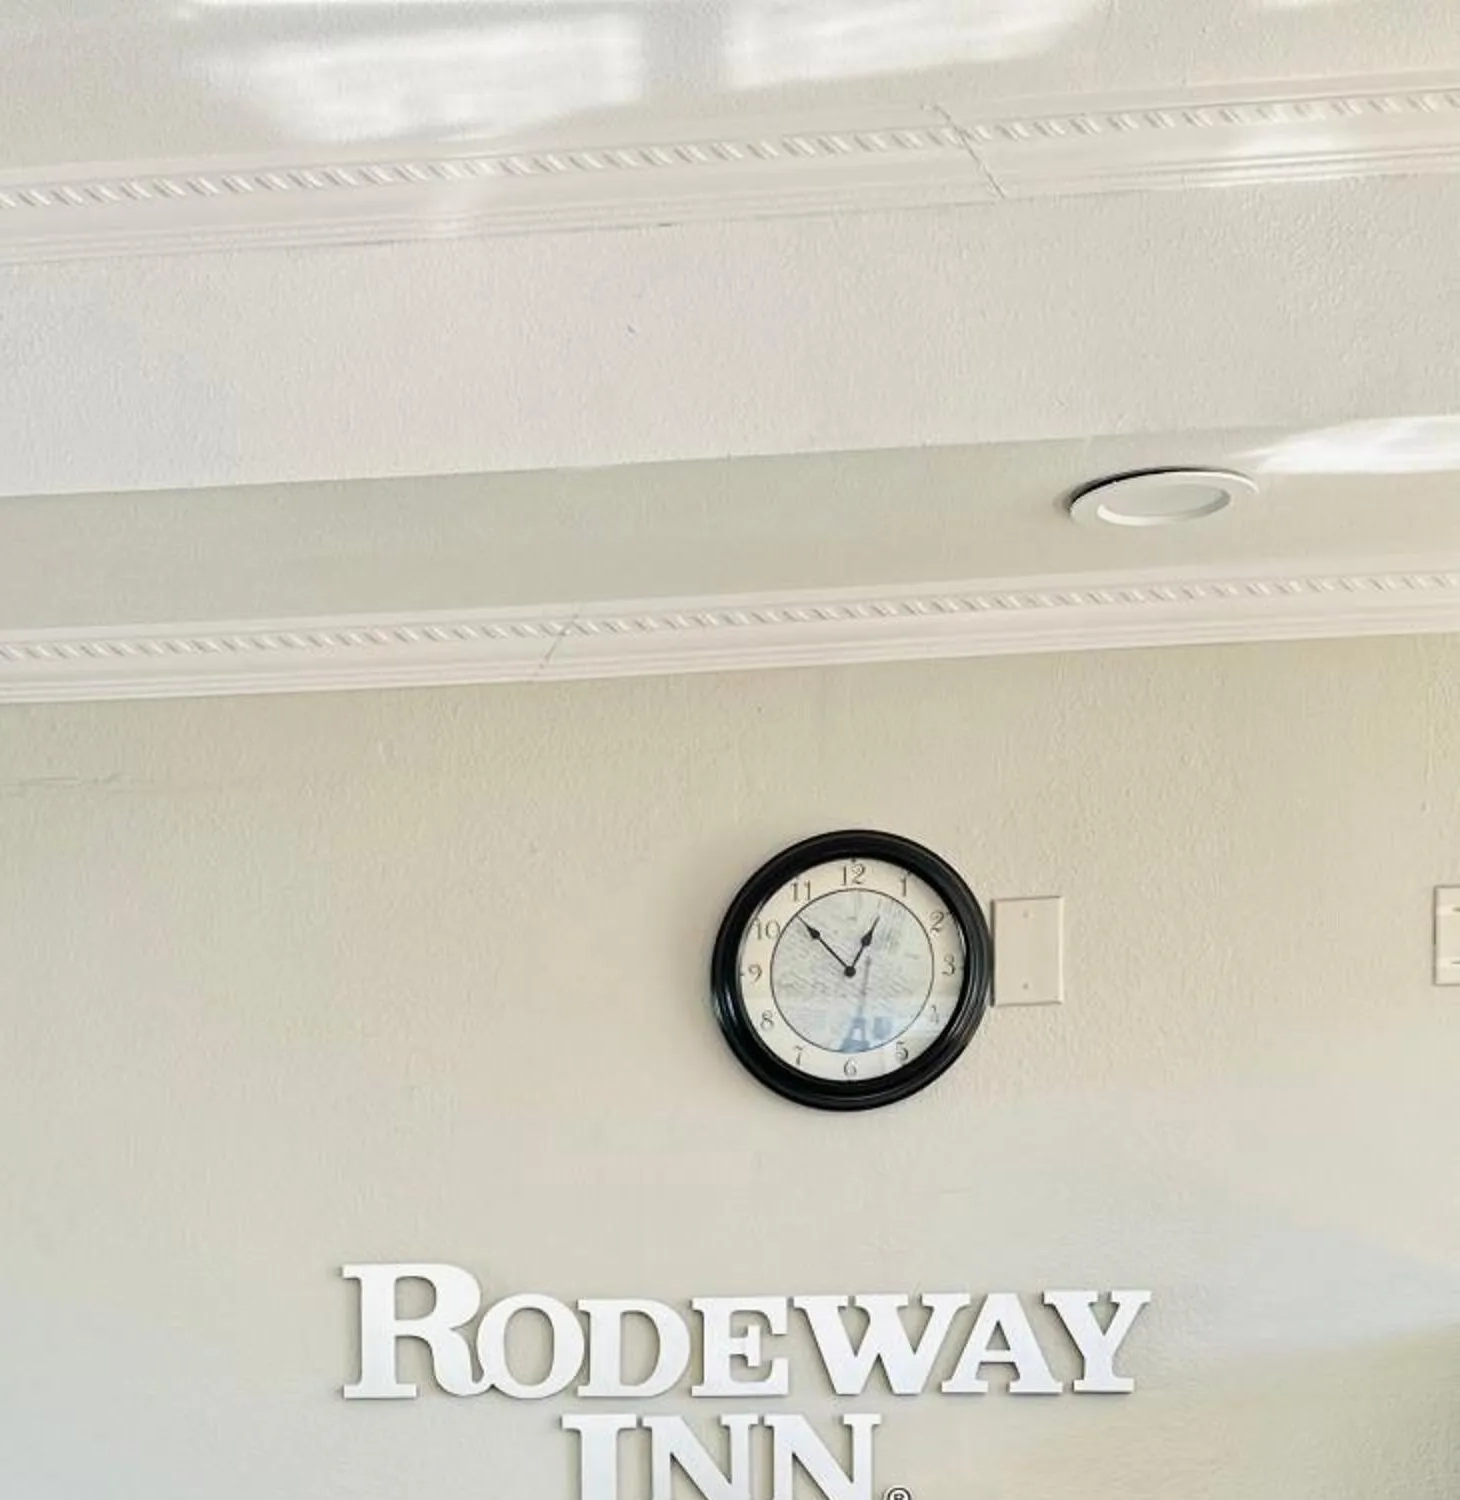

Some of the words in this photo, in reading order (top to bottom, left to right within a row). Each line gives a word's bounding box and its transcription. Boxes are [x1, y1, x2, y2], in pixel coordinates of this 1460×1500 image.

[840, 863, 865, 887] 12
[791, 880, 813, 901] 11
[900, 877, 908, 897] 1
[753, 919, 781, 940] 10
[930, 911, 944, 933] 2
[748, 965, 763, 983] 9
[942, 954, 956, 976] 3
[760, 1011, 776, 1030] 8
[895, 1041, 909, 1062] 5
[843, 1058, 857, 1077] 6
[341, 1262, 1152, 1399] RODEWAY
